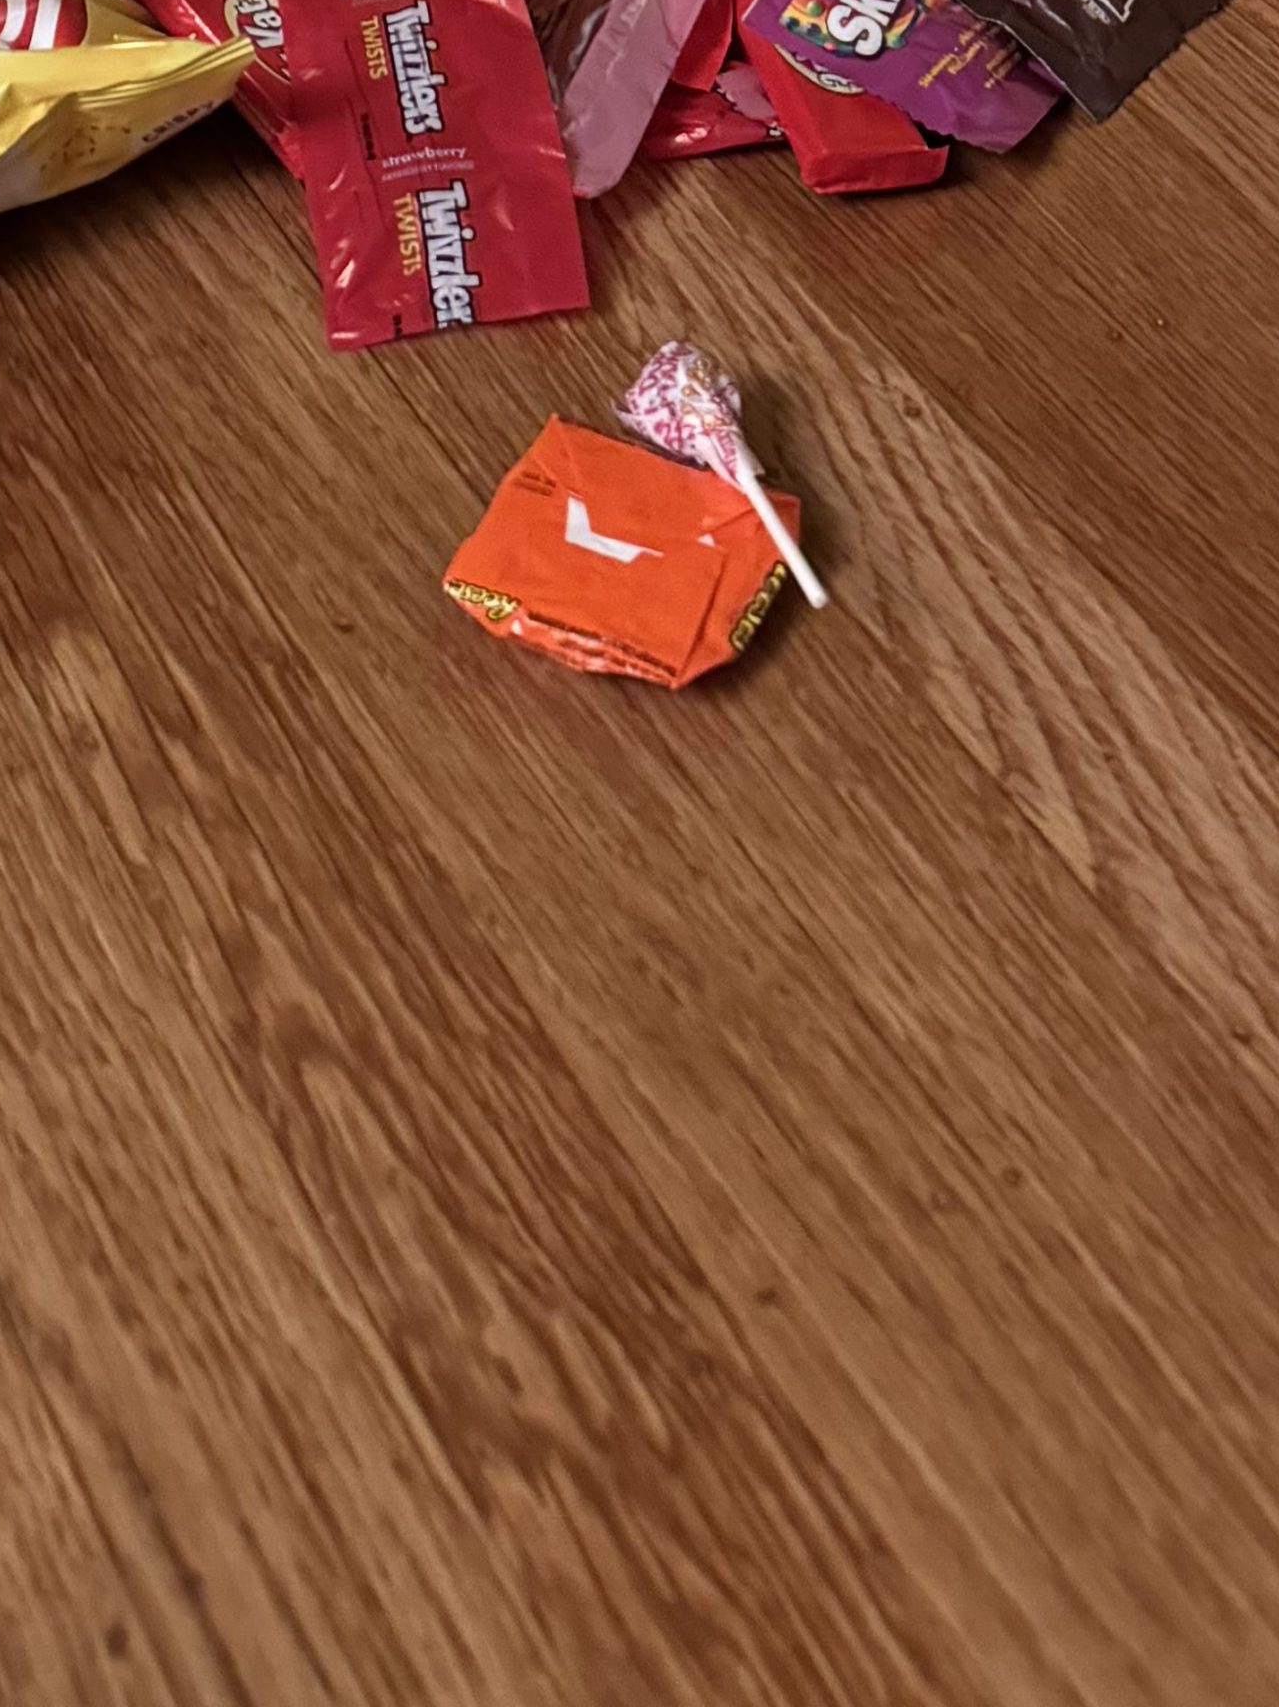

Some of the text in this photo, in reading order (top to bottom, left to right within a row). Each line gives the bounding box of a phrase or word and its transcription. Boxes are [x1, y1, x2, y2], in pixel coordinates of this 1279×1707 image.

[359, 14, 389, 82] TWISTS
[384, 0, 446, 136] Twizzlers
[392, 191, 423, 278] TWISTS
